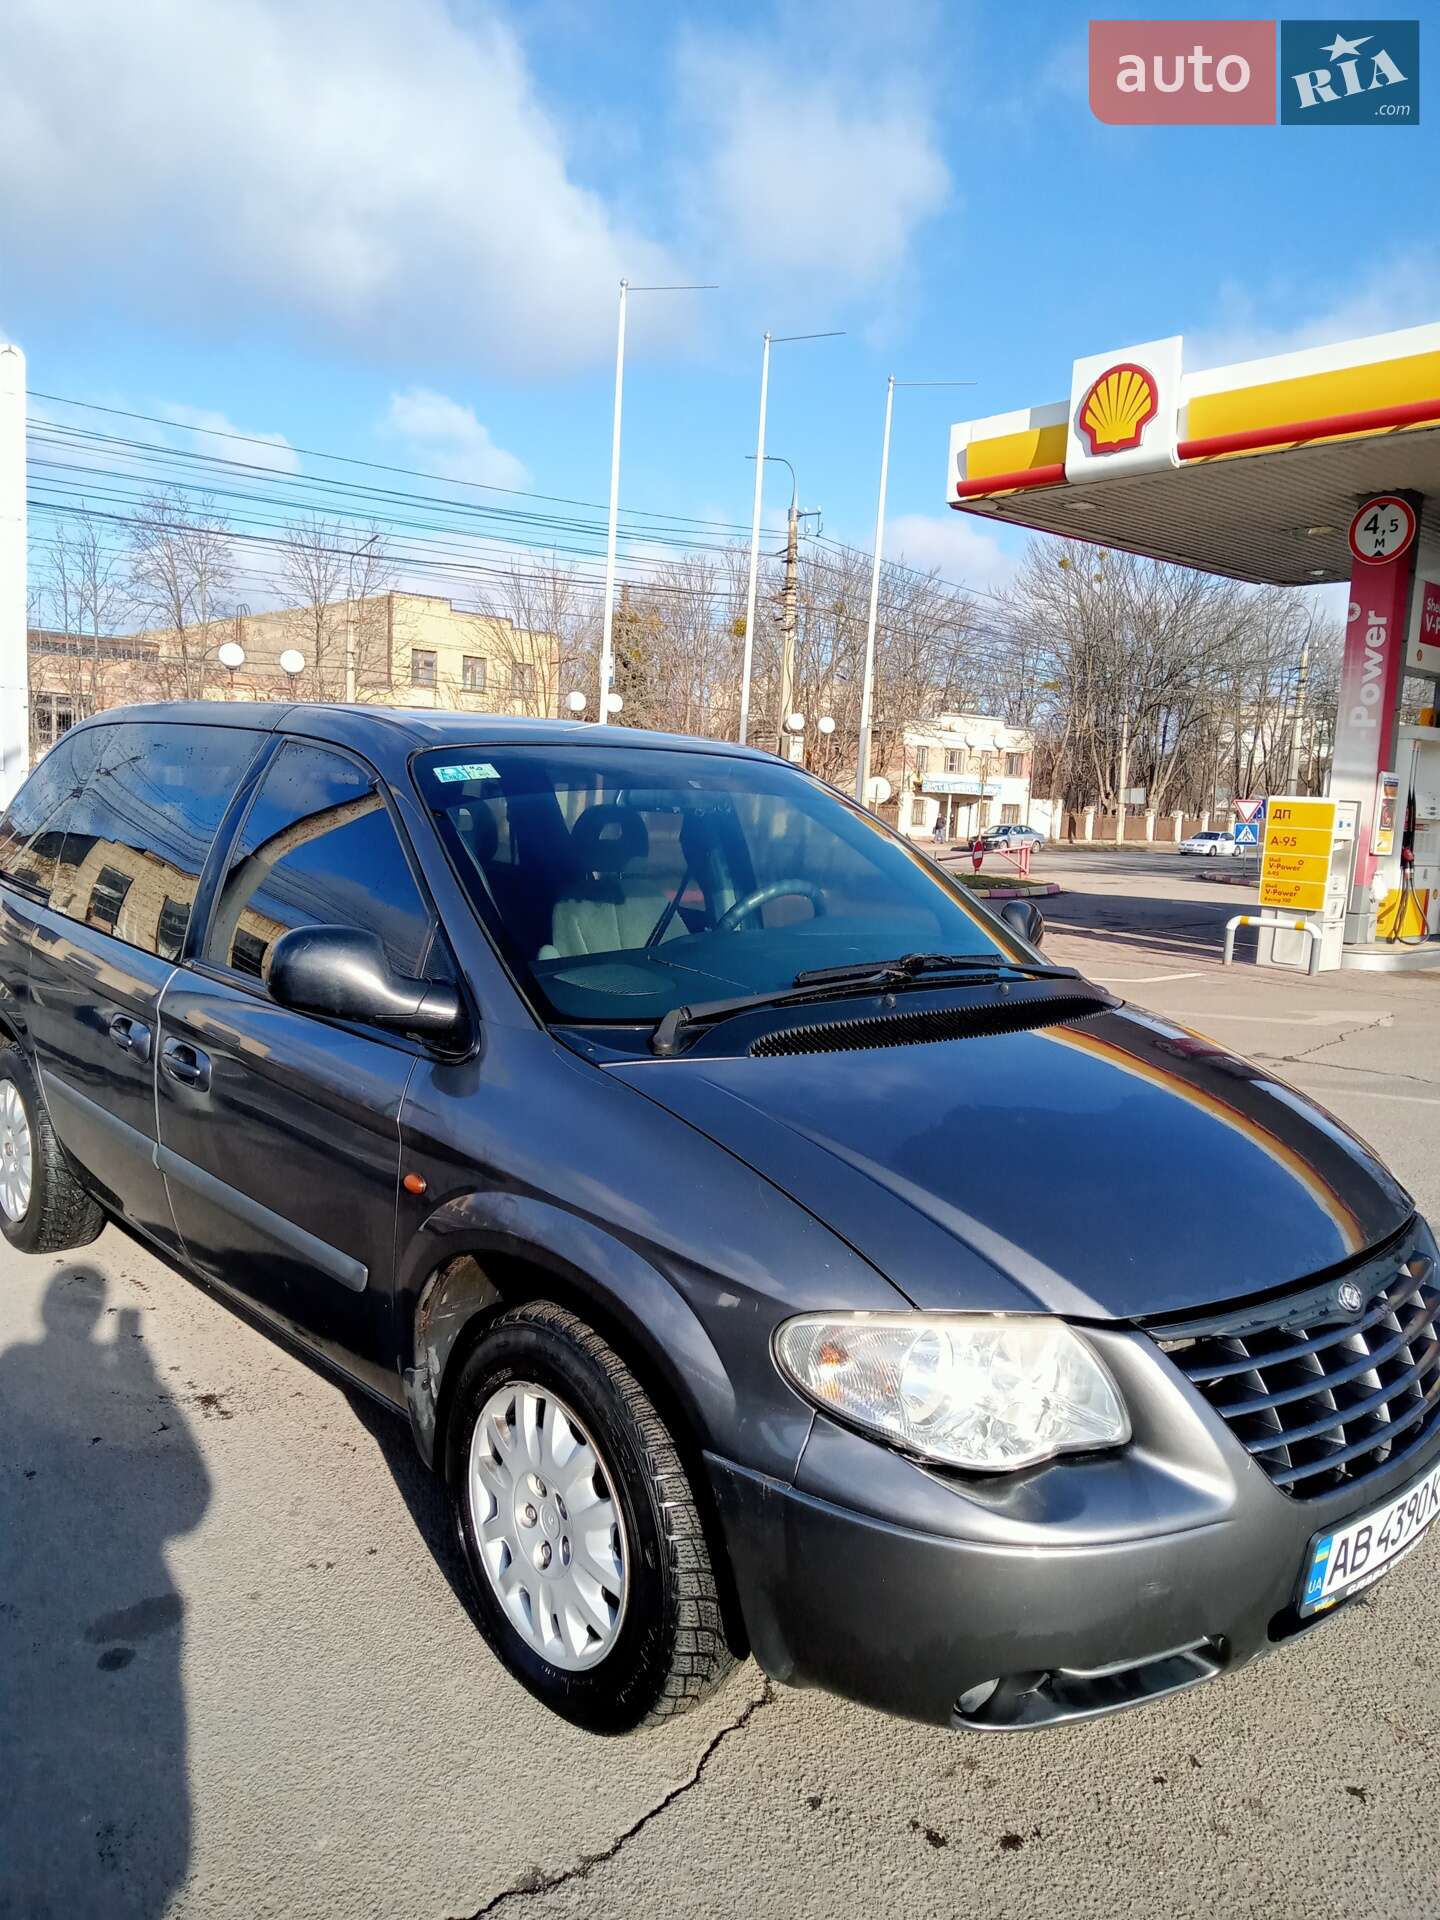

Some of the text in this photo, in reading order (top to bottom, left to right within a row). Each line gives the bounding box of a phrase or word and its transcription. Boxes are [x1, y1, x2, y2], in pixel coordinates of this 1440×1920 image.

[1363, 513, 1399, 537] 4,5
[1273, 808, 1292, 820] ДП
[1268, 862, 1301, 872] V-Power
[1265, 888, 1297, 897] V-Power
[1307, 1577, 1323, 1594] UA
